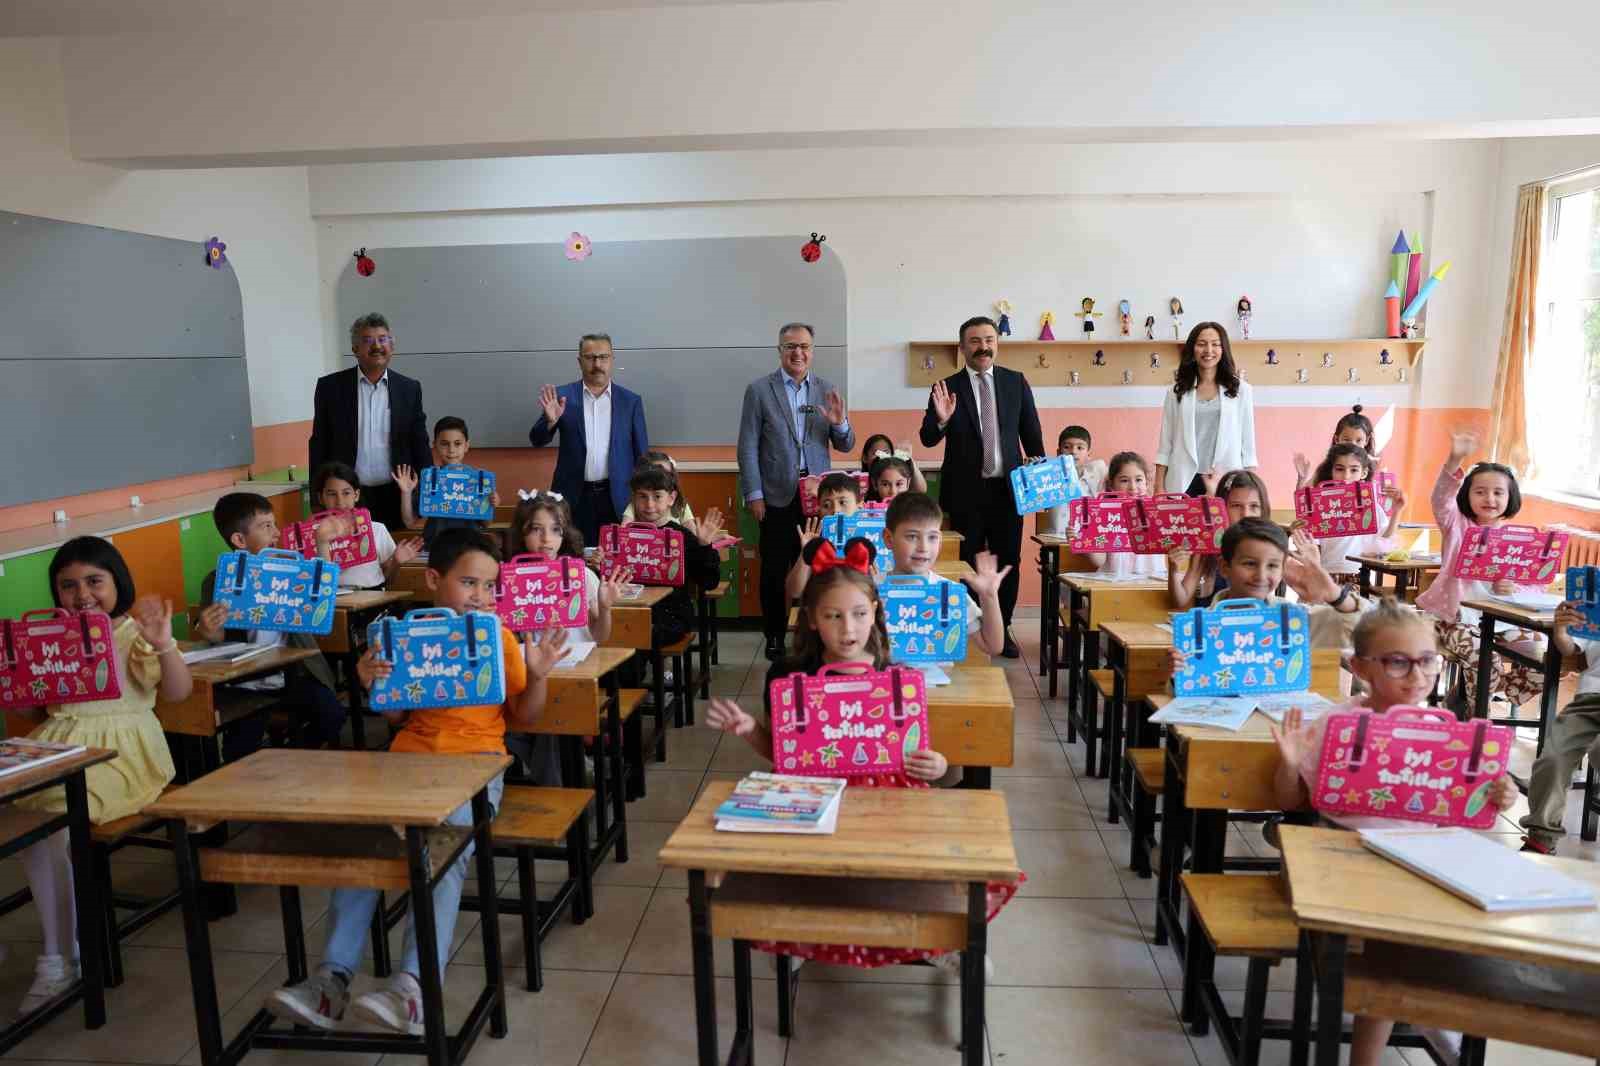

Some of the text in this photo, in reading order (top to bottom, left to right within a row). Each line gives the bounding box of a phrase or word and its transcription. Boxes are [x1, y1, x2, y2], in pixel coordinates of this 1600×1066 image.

[271, 576, 289, 591] iyi
[525, 579, 542, 592] iyi
[898, 604, 917, 619] iyi
[1233, 631, 1255, 648] iyi
[42, 642, 60, 658] iyi
[422, 643, 442, 659] iyi
[1218, 649, 1274, 666] tatiller
[408, 661, 462, 678] tatiller
[840, 700, 862, 719] iyi
[822, 720, 886, 740] tatiller
[1403, 747, 1432, 768] iyi
[1377, 767, 1453, 791] tatiller
